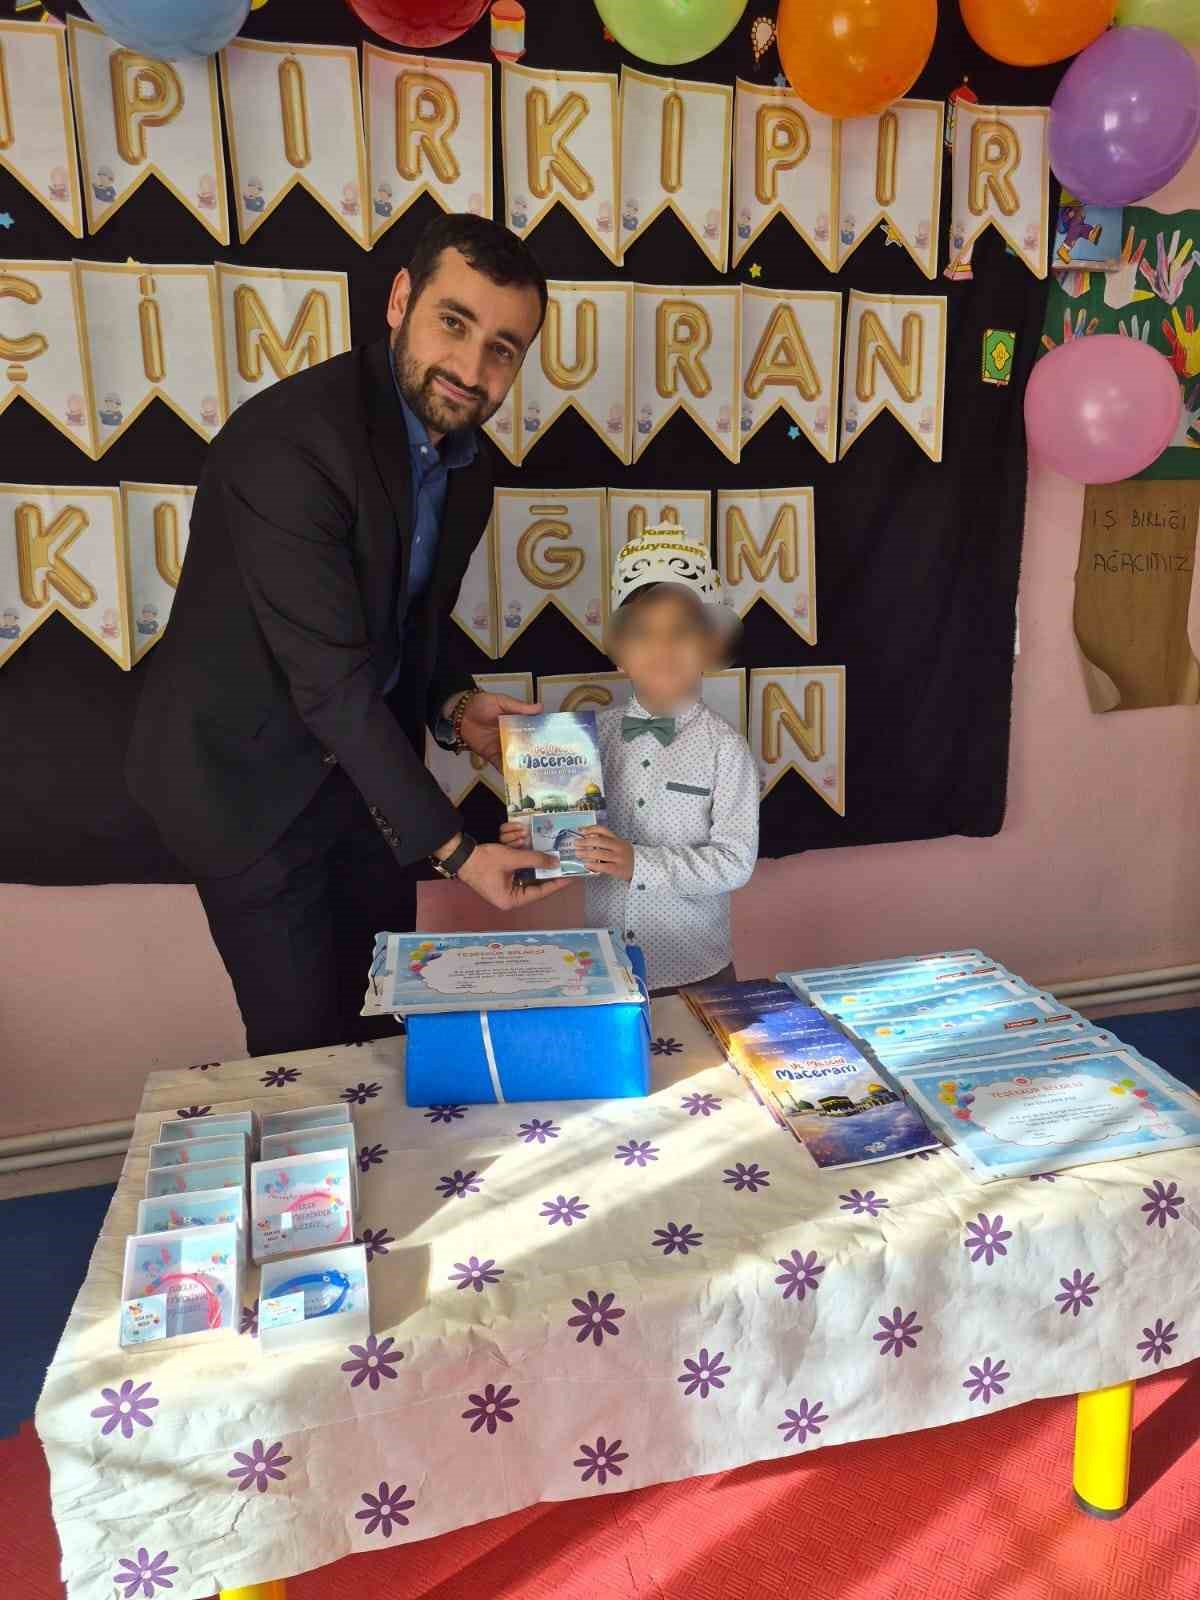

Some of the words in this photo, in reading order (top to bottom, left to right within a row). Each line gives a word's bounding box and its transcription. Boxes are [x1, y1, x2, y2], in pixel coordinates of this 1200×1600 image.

[0, 48, 460, 184] PIR
[541, 299, 923, 402] URAN
[775, 1064, 858, 1080] Maceram
